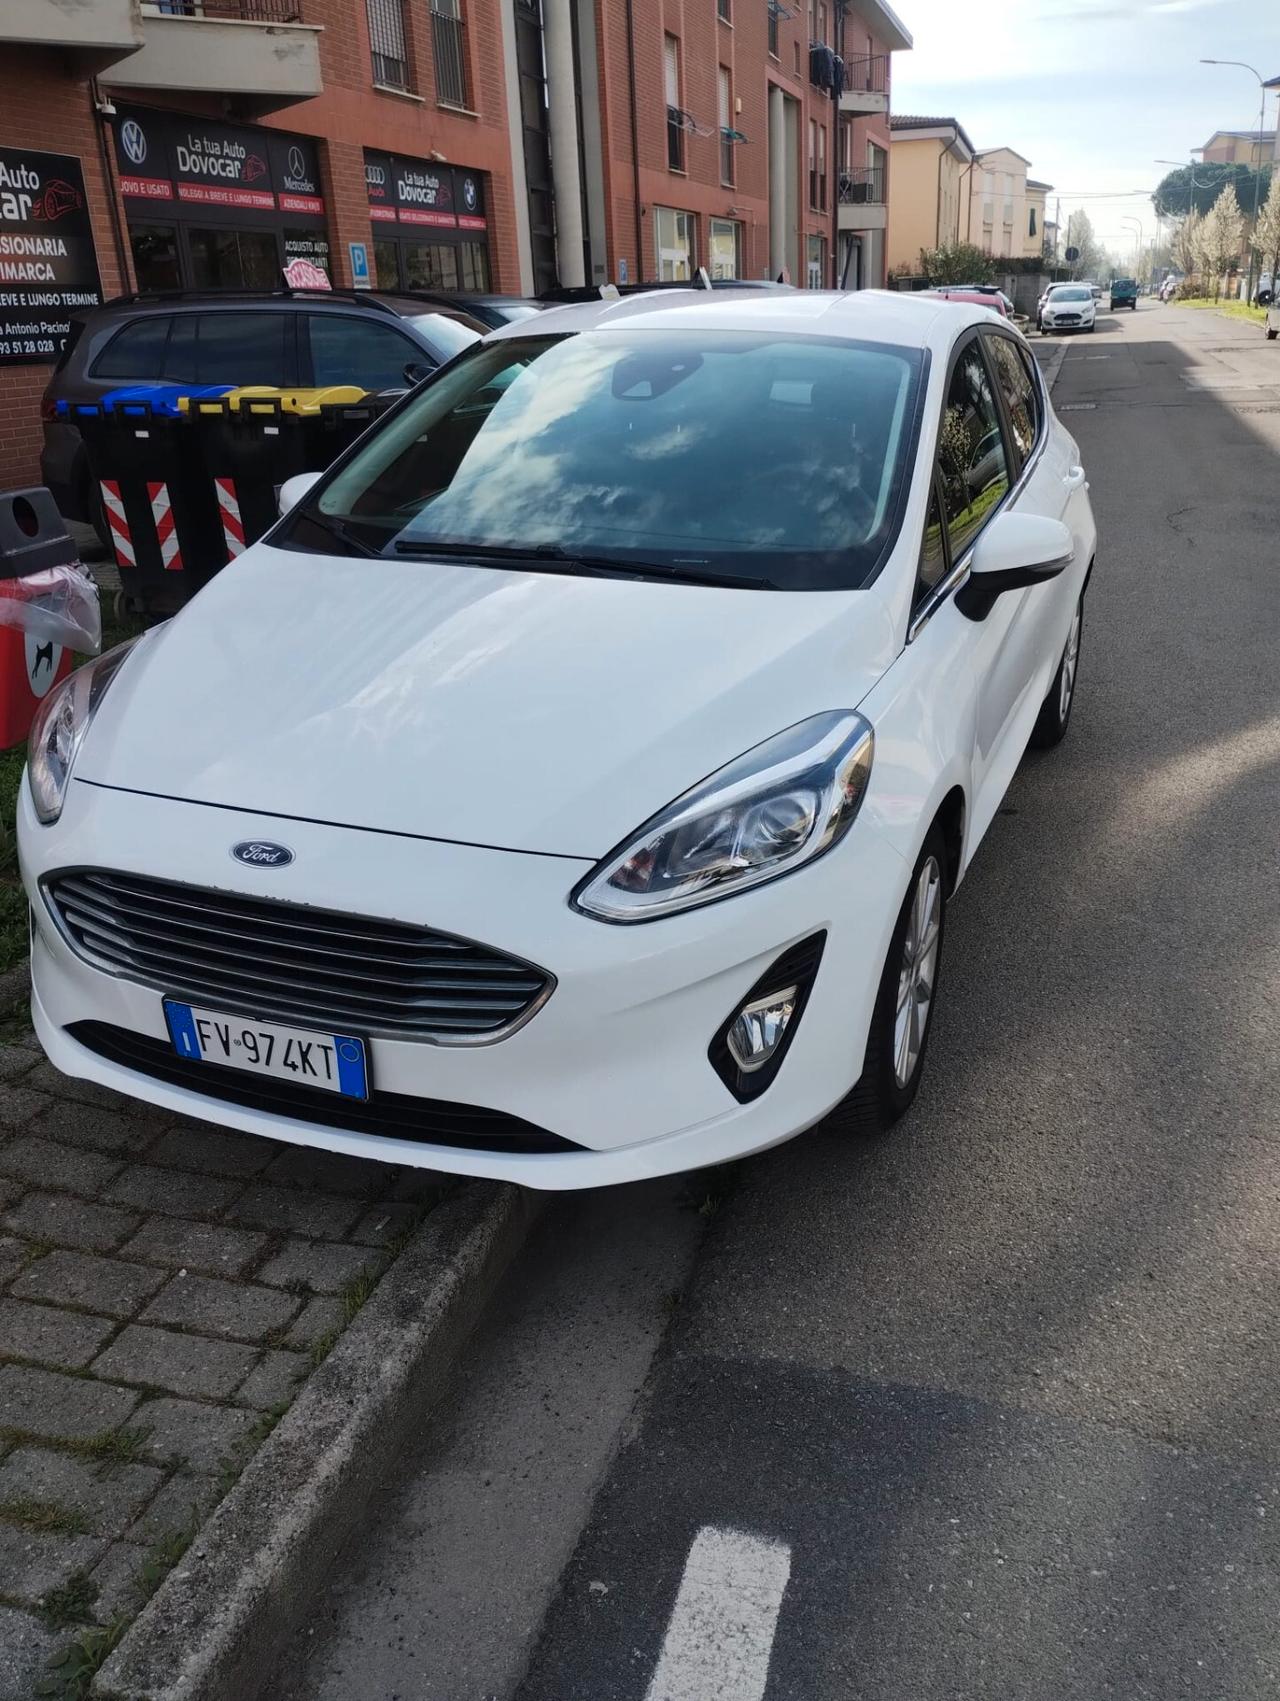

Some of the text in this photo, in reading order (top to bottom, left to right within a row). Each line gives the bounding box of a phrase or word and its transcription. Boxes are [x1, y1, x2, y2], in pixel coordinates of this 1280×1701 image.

[188, 134, 246, 159] La tua Auto
[176, 146, 242, 178] Dovocar
[0, 161, 39, 190] Auto
[283, 176, 315, 192] Mercedes
[404, 170, 440, 188] La tua Auto
[120, 181, 170, 196] UOVO E USATO
[209, 190, 229, 202] BREVE
[233, 194, 253, 204] LUNGO
[398, 180, 437, 204] Dovocar
[0, 192, 32, 221] ar
[0, 235, 67, 256] SIONARIA
[285, 240, 329, 253] ACQUISTO AUTO
[0, 293, 98, 306] EVE E LUNGO TERMINE
[5, 322, 40, 335] Antonio
[40, 321, 70, 334] Pacino
[12, 341, 23, 354] 51
[24, 340, 36, 353] 28
[37, 340, 55, 352] 028
[242, 843, 281, 863] Ford
